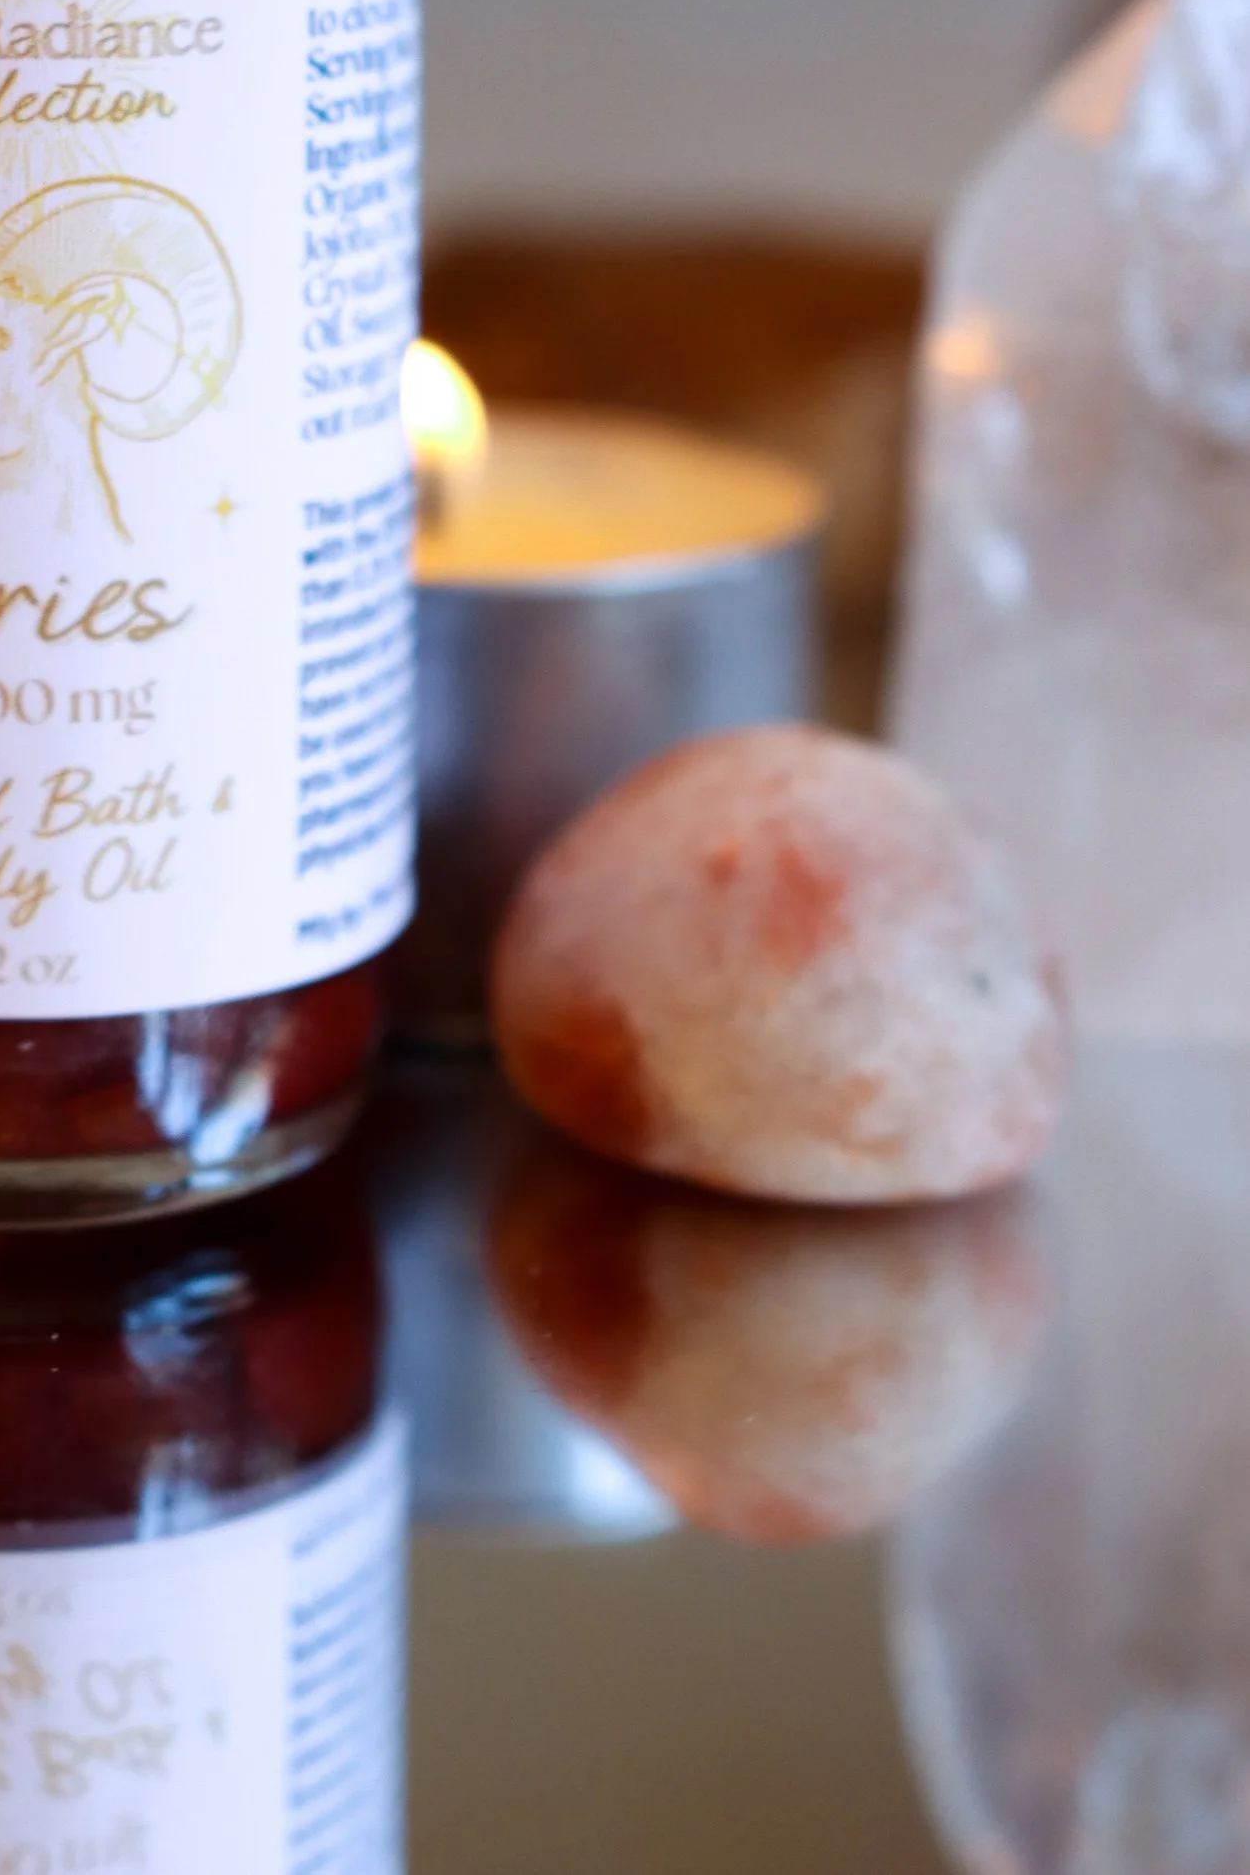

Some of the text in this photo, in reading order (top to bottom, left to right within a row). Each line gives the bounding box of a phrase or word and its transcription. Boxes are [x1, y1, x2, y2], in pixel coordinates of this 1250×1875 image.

[68, 679, 158, 737] mg
[32, 762, 190, 839] Bath
[81, 836, 179, 903] Oil
[19, 954, 79, 985] oz
